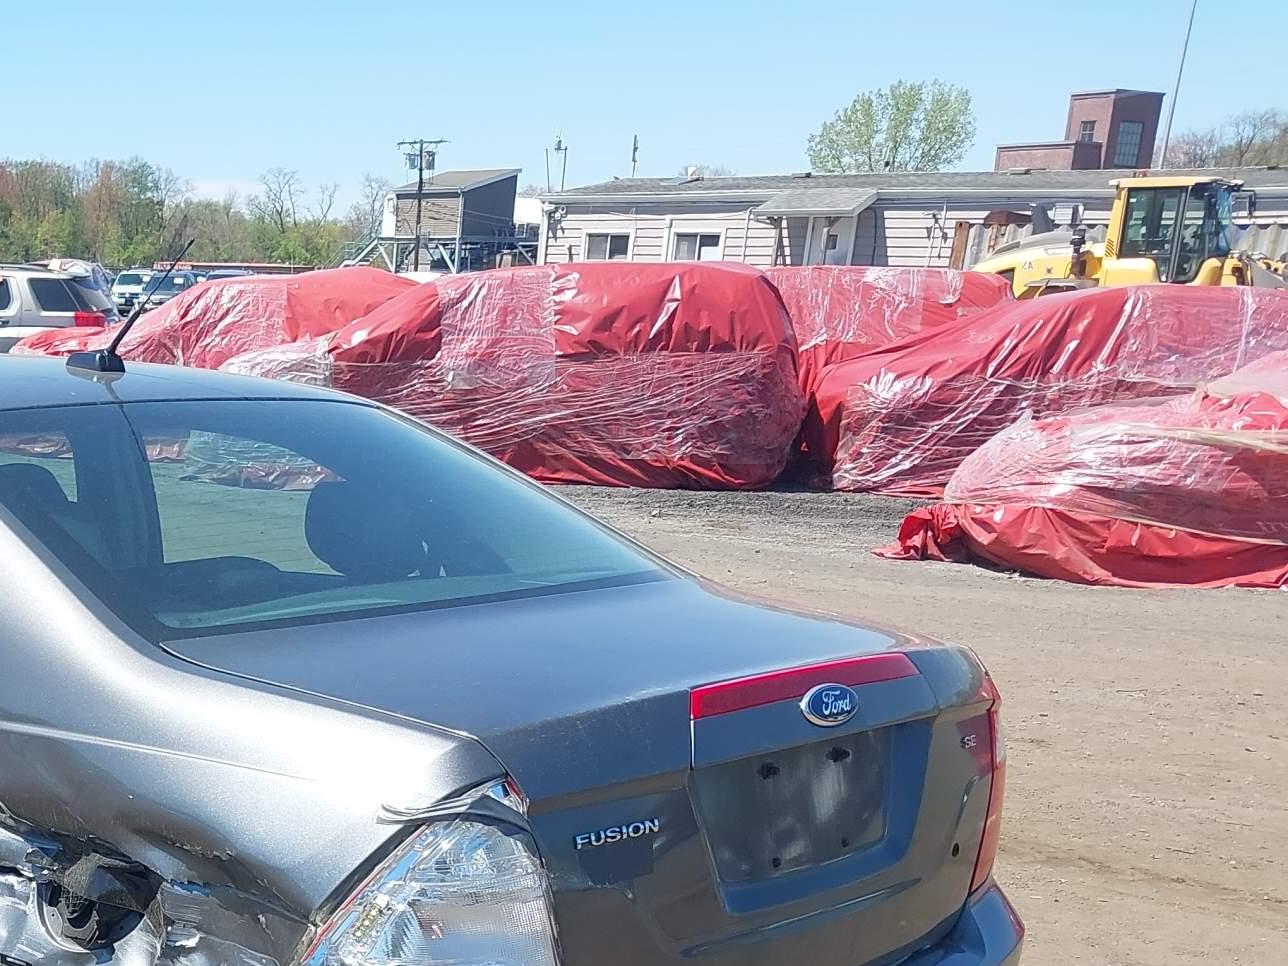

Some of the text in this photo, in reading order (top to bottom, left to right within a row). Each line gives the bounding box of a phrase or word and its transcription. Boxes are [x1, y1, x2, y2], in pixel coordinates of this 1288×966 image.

[822, 690, 852, 716] Ford
[964, 734, 977, 749] SE
[575, 818, 660, 850] FUSION
